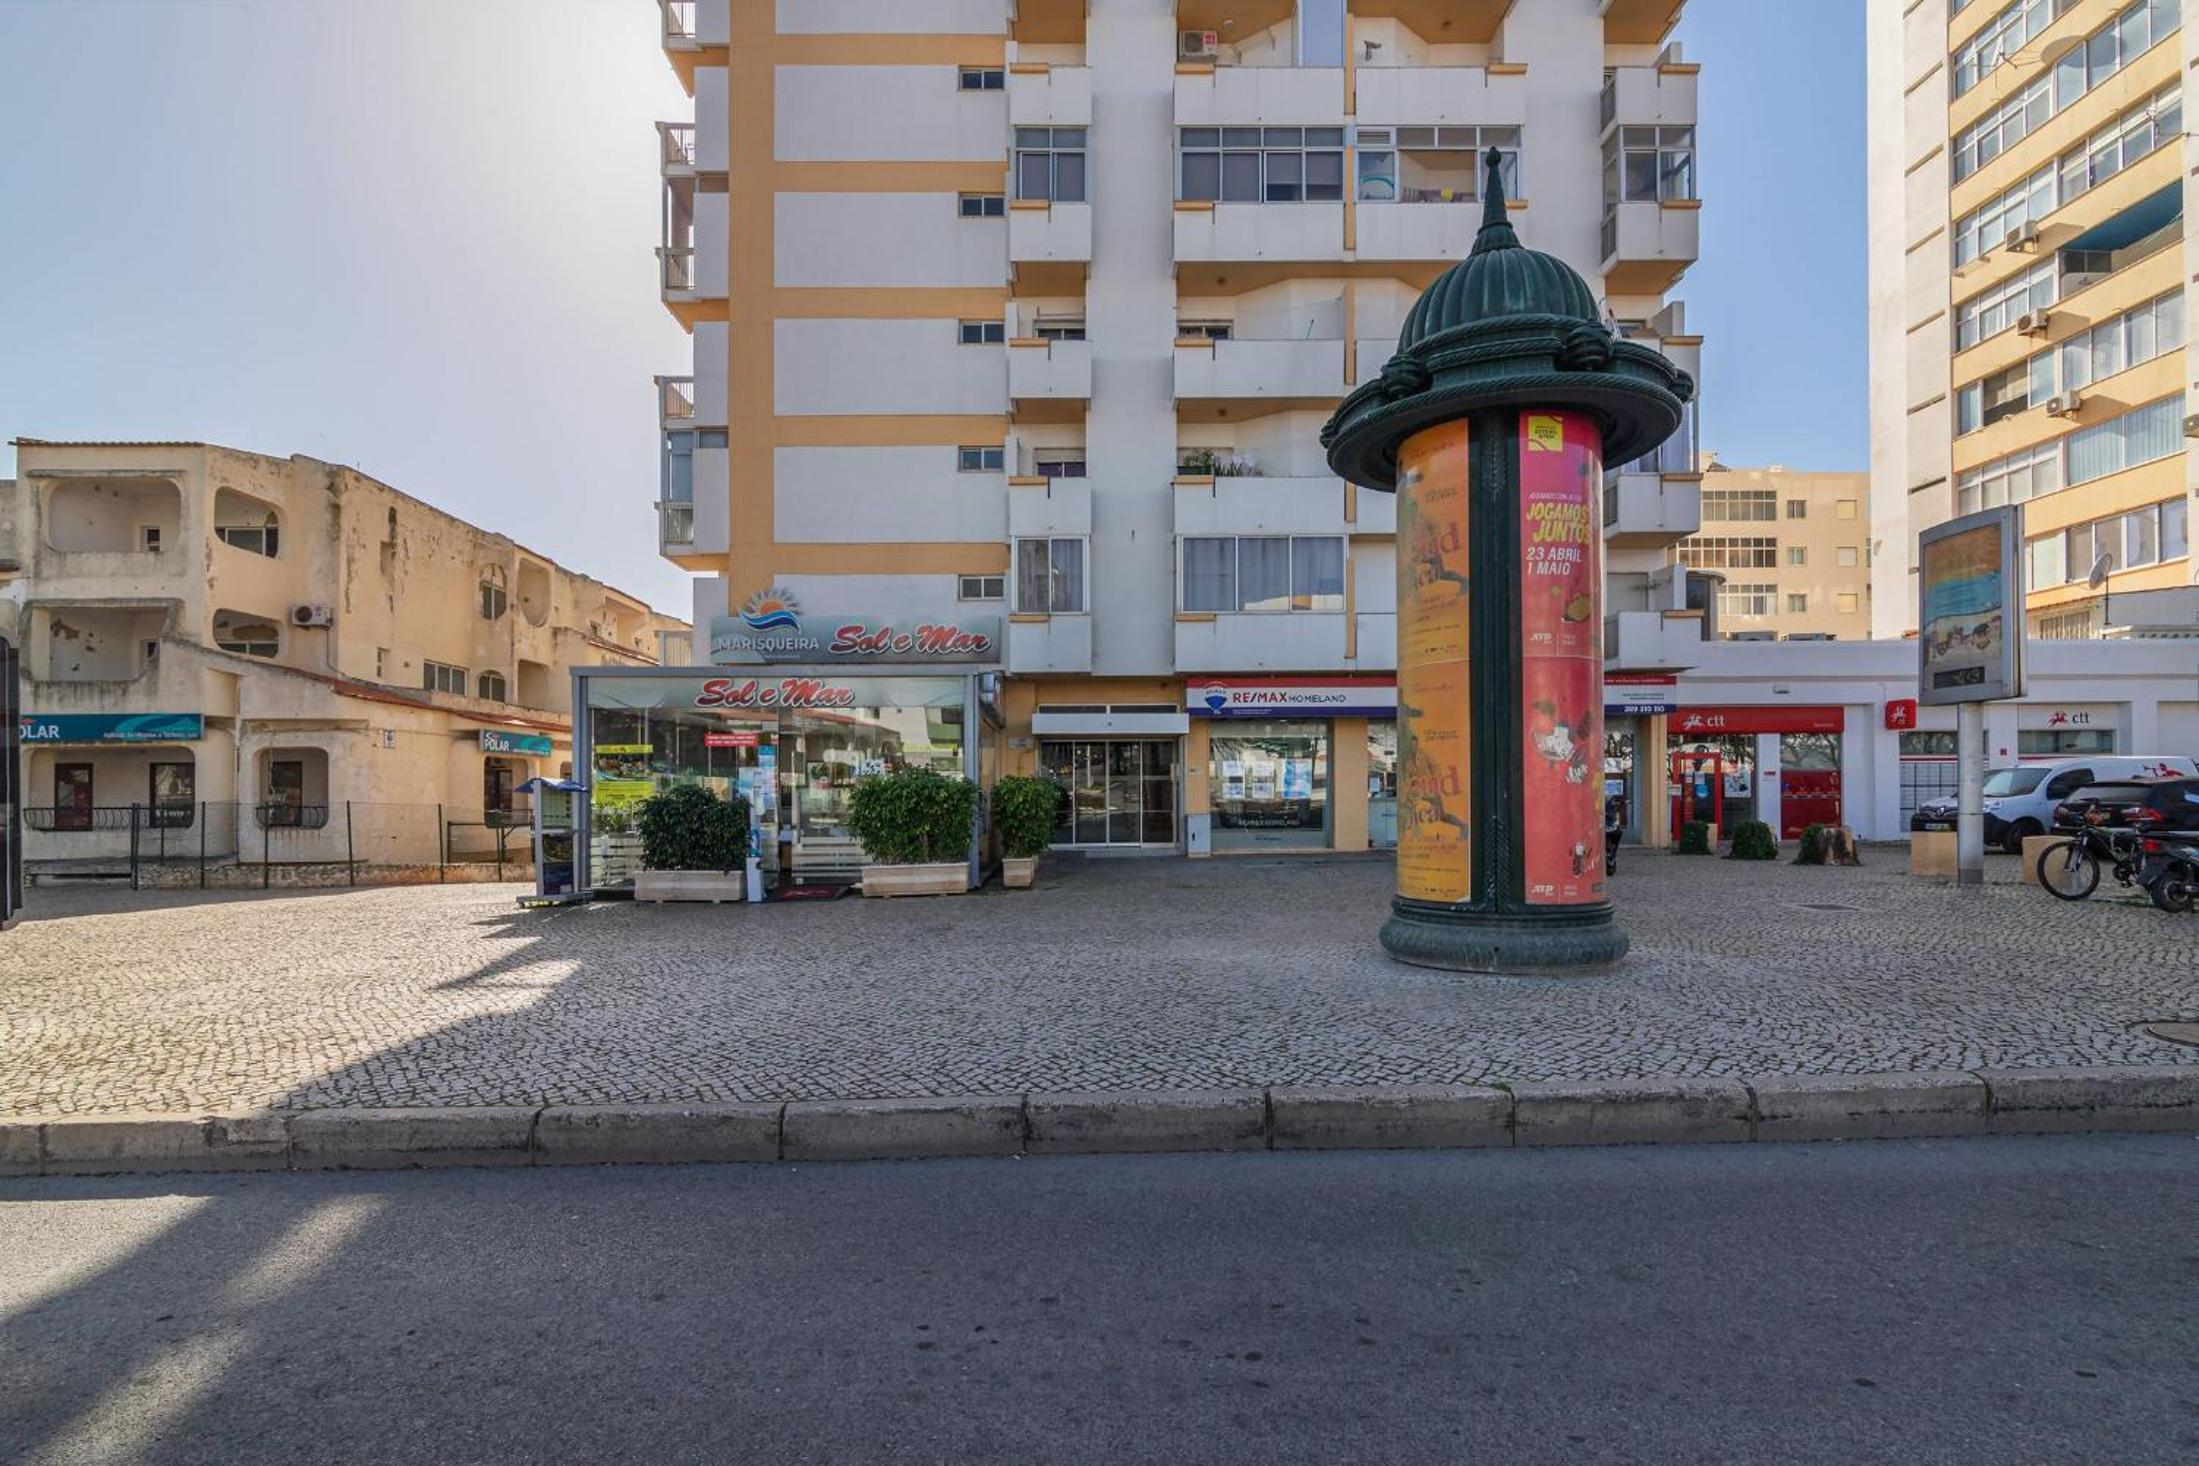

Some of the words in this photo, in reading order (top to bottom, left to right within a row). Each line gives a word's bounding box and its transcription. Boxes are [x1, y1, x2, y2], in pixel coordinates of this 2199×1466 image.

[1526, 502, 1590, 522] JOGAMOS
[1532, 520, 1592, 544] JUNTOS
[1526, 546, 1544, 561] 23
[1548, 547, 1583, 562] ABRIL
[1527, 562, 1534, 575] 1
[1536, 562, 1571, 575] MAIO
[718, 637, 820, 651] MARISQUEIRA
[829, 625, 892, 654] Sol
[893, 633, 912, 652] e
[914, 624, 991, 655] Mar
[696, 677, 757, 708] Sol
[758, 686, 779, 706] e
[779, 676, 855, 708] Mar
[1232, 692, 1288, 703] RE/MAX
[1289, 694, 1347, 703] HOMELAND
[1706, 714, 1725, 727] ctt
[2072, 711, 2089, 724] ctt
[484, 738, 510, 752] POLAR
